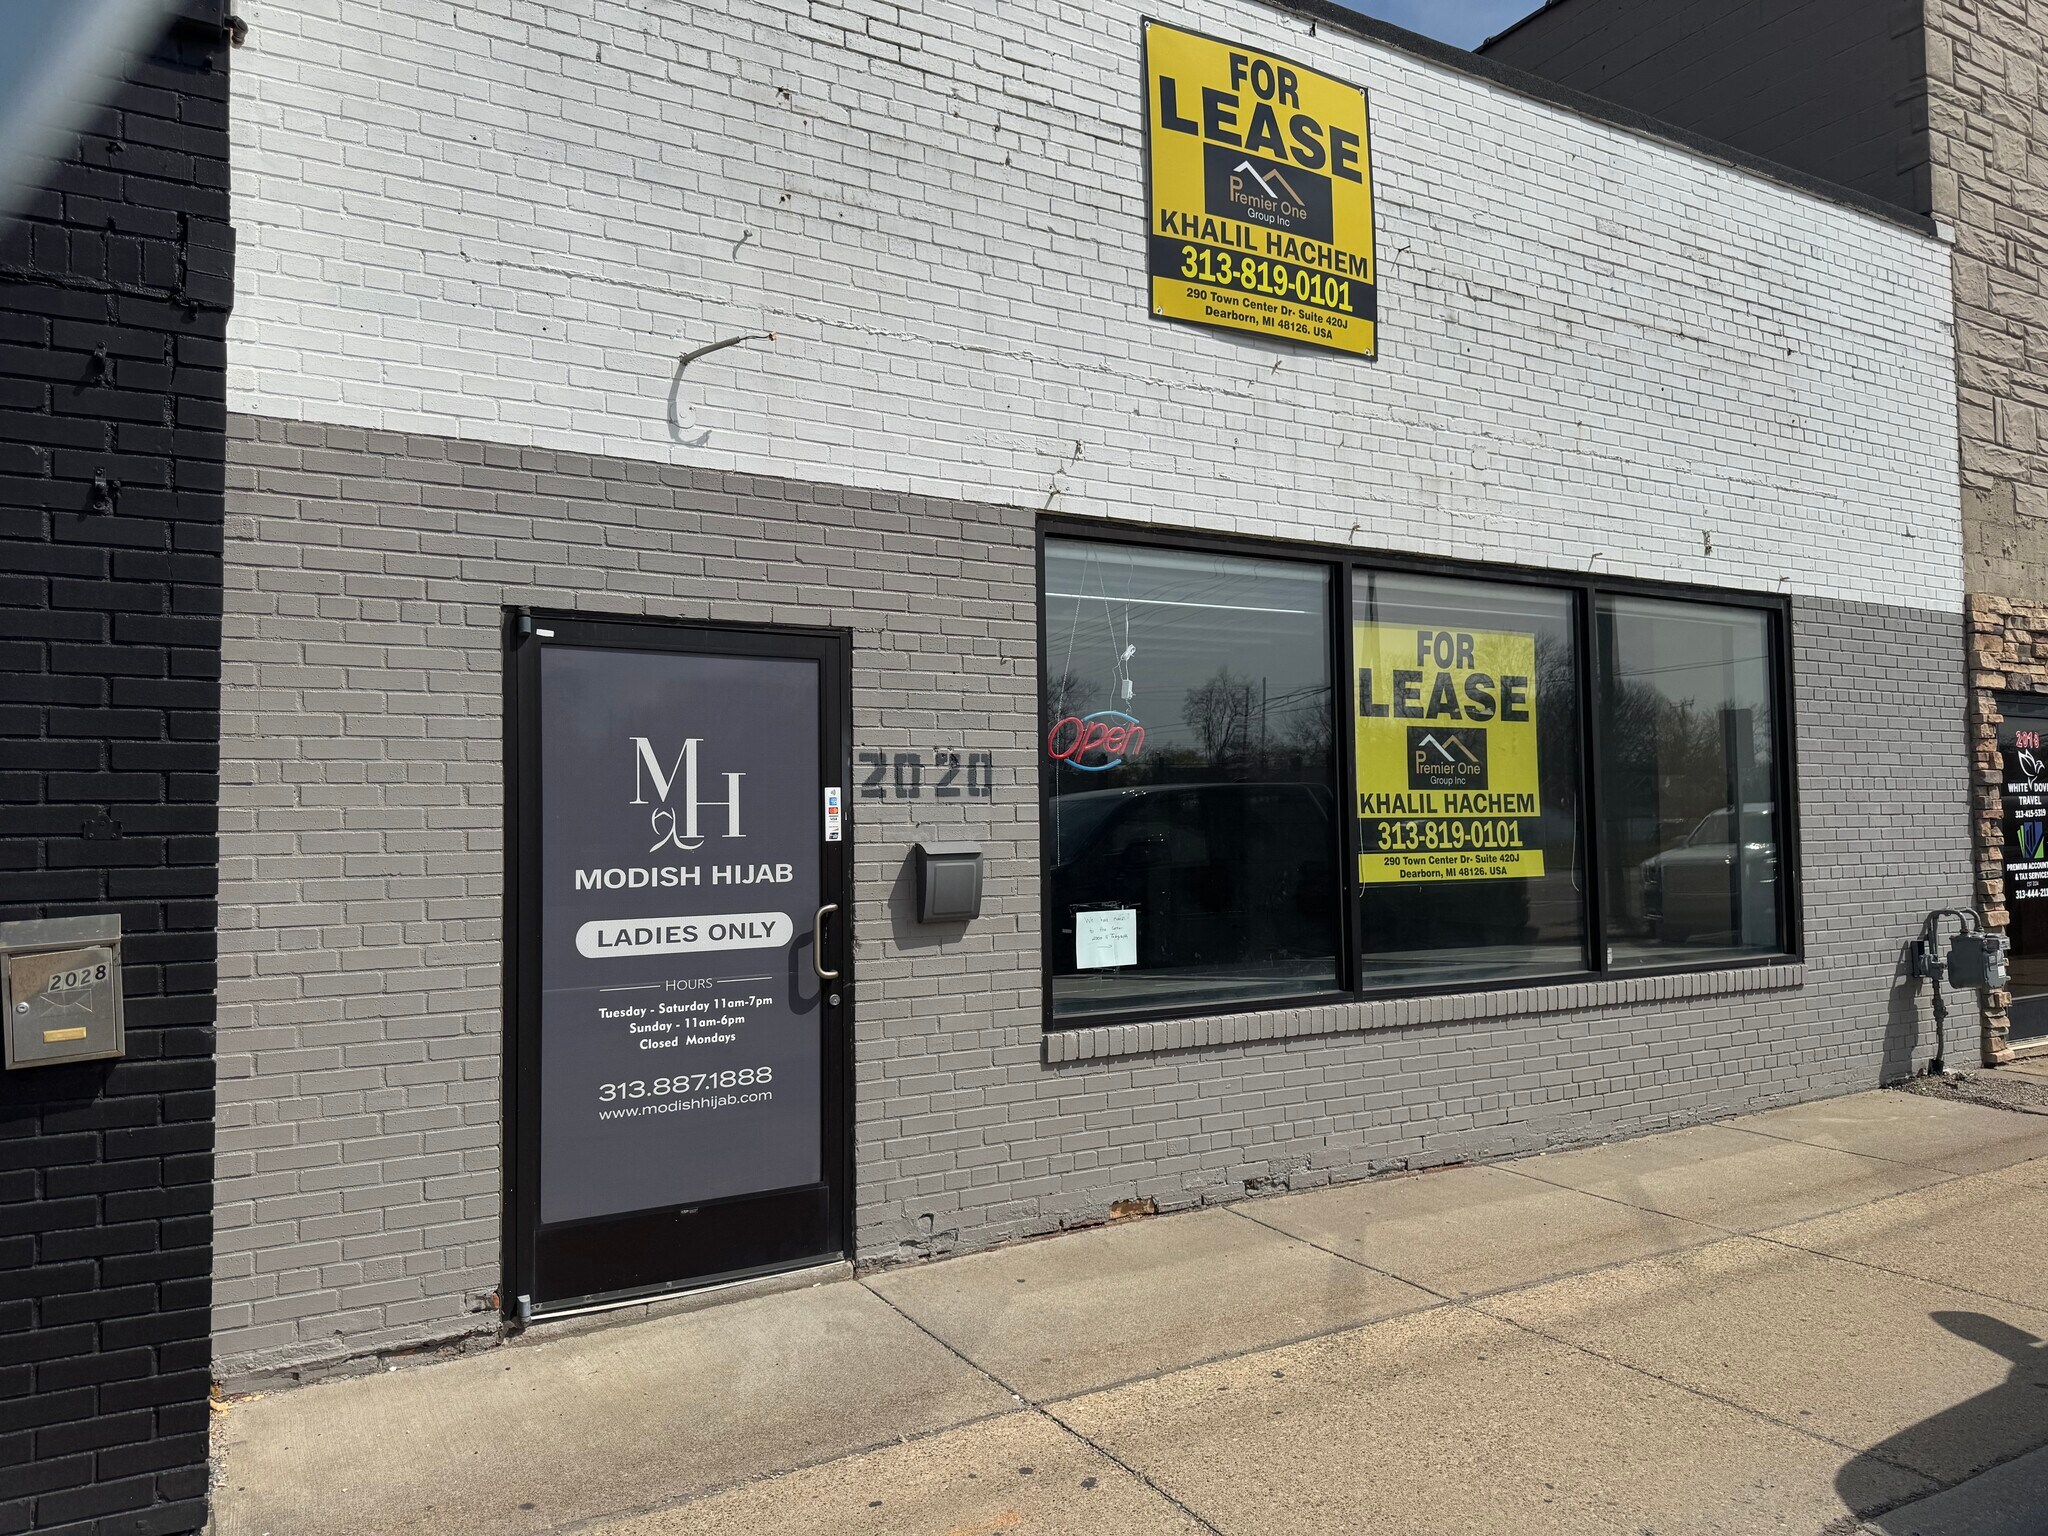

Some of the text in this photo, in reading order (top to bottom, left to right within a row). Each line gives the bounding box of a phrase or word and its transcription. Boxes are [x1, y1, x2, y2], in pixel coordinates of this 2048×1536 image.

[1229, 52, 1300, 109] FOR
[1159, 75, 1363, 184] LEASE
[1229, 175, 1307, 220] Premier One
[1247, 207, 1290, 227] Group Inc
[1161, 208, 1368, 279] KHALIL HACHEM
[1181, 245, 1353, 312] 313-819-0101
[1186, 287, 1207, 300] 290
[1210, 291, 1239, 306] Town
[1242, 297, 1278, 314] Center
[1298, 309, 1323, 324] Suite
[1326, 315, 1348, 329] 420J
[1205, 305, 1333, 340] Dearborn, MI 48126. USA
[1416, 630, 1475, 669] FOR
[1358, 667, 1529, 722] LEASE
[1047, 717, 1145, 763] Open
[2015, 730, 2040, 749] 2018
[859, 752, 993, 798] 2020
[1415, 750, 1481, 775] Premier One
[1430, 776, 1466, 786] Group Inc
[2007, 782, 2029, 793] WHITE
[1360, 792, 1535, 814] KHALIL HACHEM
[2018, 796, 2042, 805] TRAVEL
[1377, 820, 1523, 850] 313-819-0101
[1383, 856, 1401, 866] 290
[1402, 856, 1426, 865] Town
[1428, 855, 1458, 865] Center
[1475, 854, 1498, 863] Suite
[1499, 853, 1520, 862] 420J
[1399, 868, 1444, 879] Dearborn,
[1446, 867, 1456, 877] MI
[1489, 866, 1507, 875] USA
[2006, 862, 2028, 871] PREMIUM
[575, 862, 794, 890] MODISH HIJAB
[2019, 872, 2028, 880] TAX
[597, 920, 777, 948] LADIES ONLY
[50, 964, 106, 991] 2028
[665, 978, 713, 991] HOURS
[599, 1006, 647, 1019] Tuesday
[658, 1000, 710, 1014] Saturday
[714, 996, 773, 1009] 11am-7pm
[629, 1021, 672, 1034] Sunday
[684, 1015, 745, 1029] 11am-6pm
[639, 1032, 736, 1050] Closed Mondays
[599, 1066, 773, 1102] 313.887.1888
[599, 1091, 773, 1120] www.modishhijab.com
